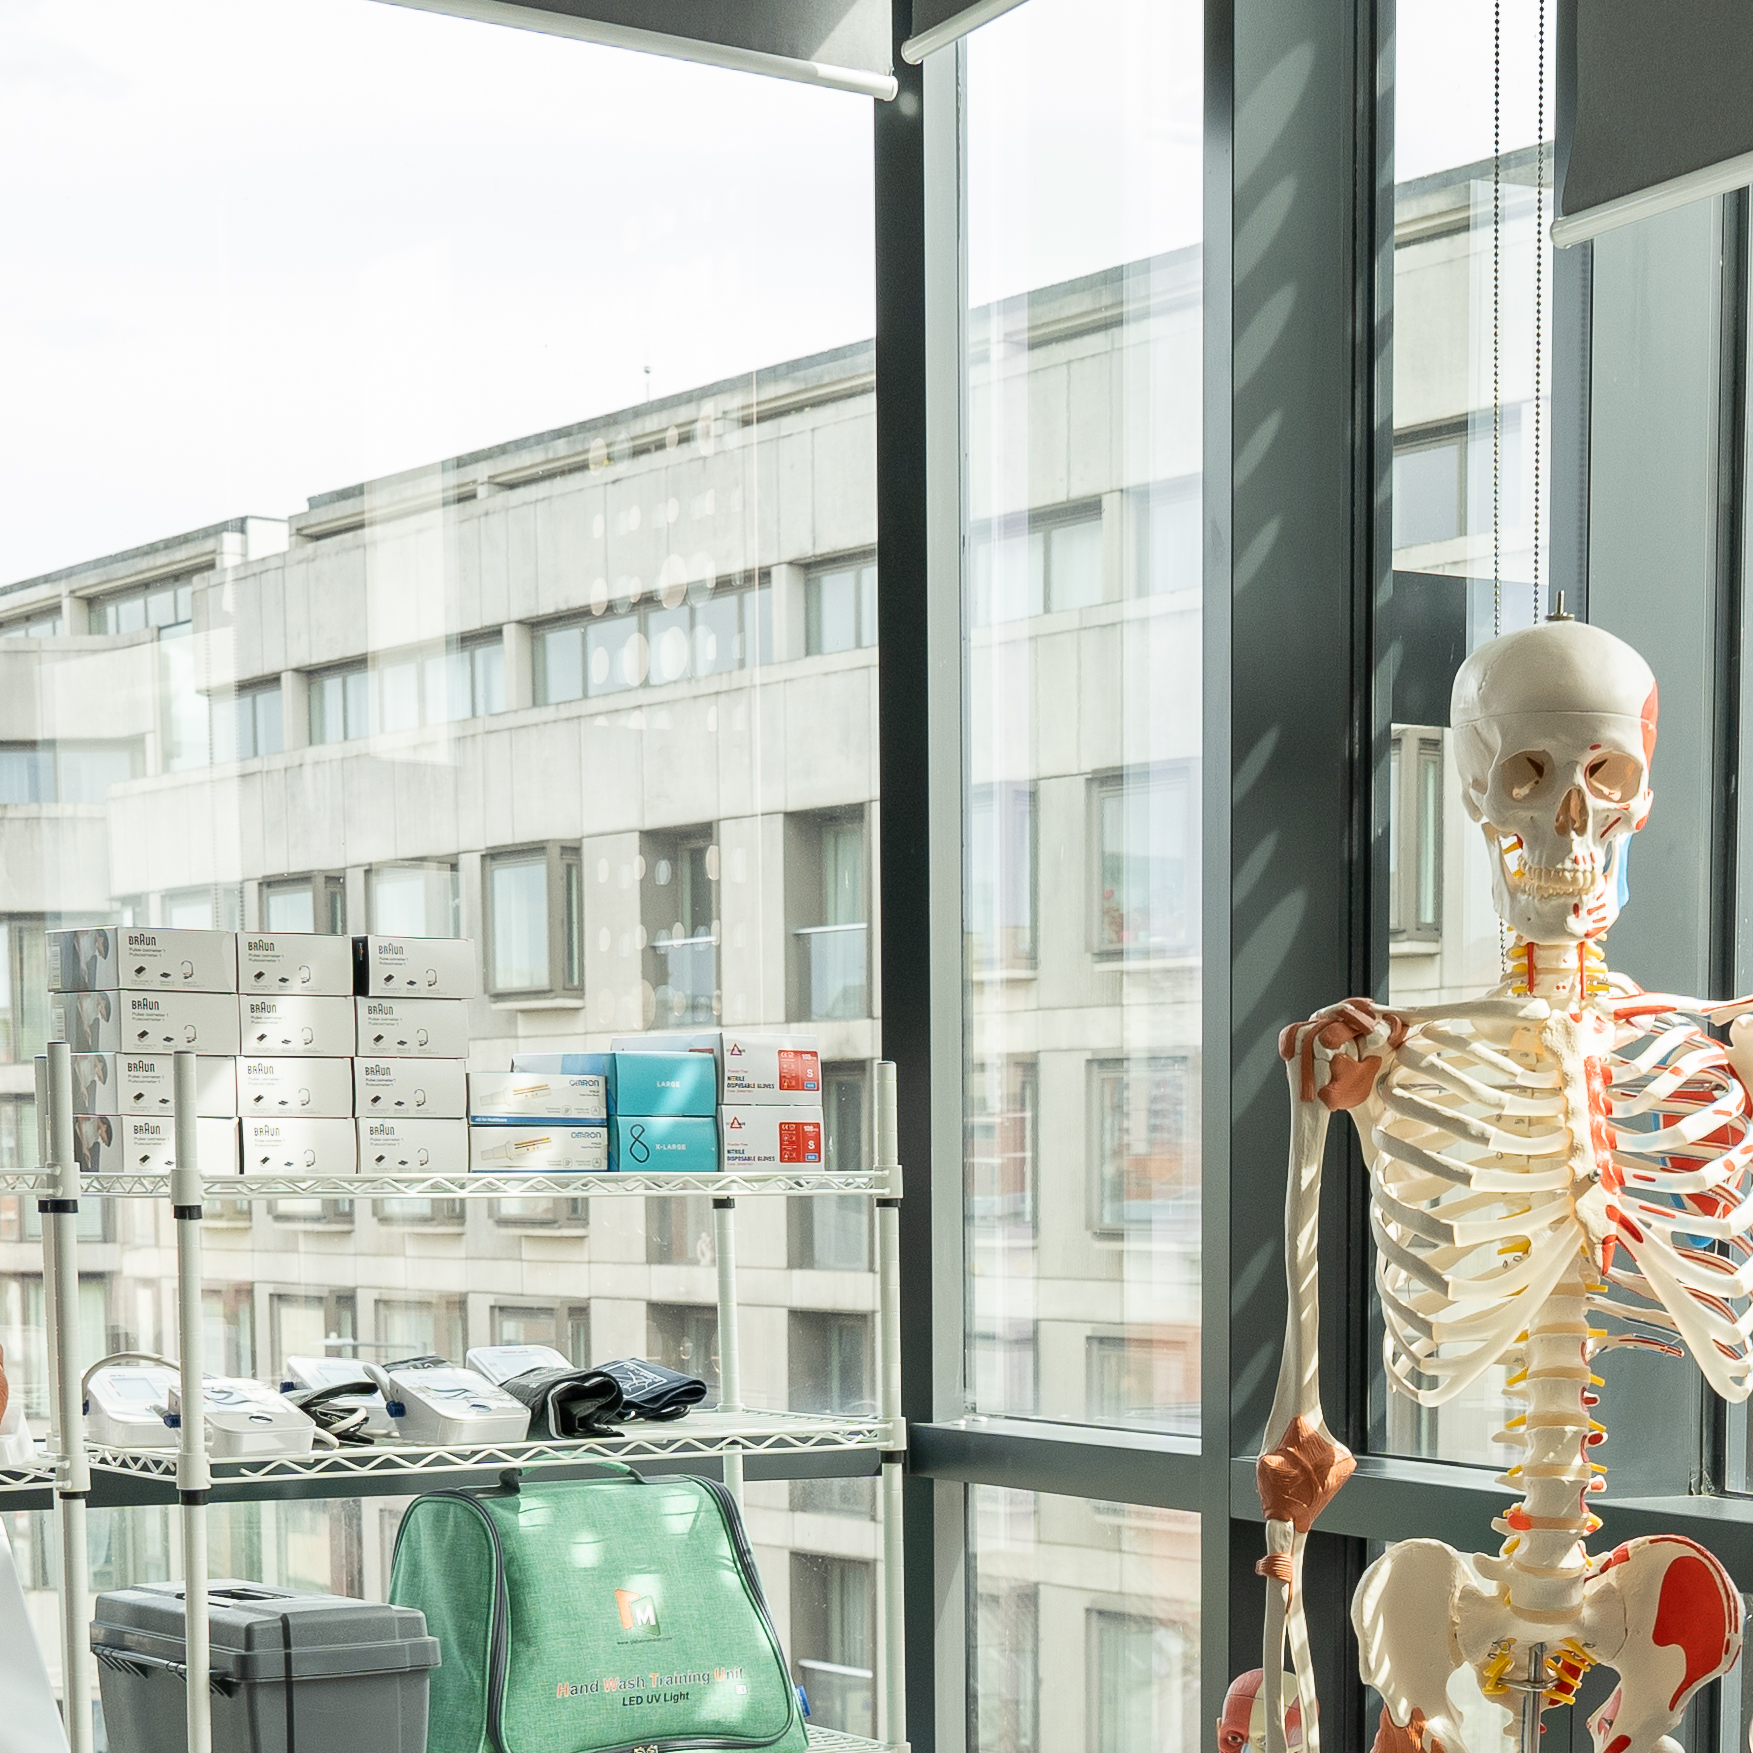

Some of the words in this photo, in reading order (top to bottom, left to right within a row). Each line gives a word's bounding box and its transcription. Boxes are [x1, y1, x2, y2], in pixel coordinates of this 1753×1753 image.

[128, 934, 156, 946] BRAUN
[248, 939, 275, 951] BRAUN
[378, 943, 404, 955] BRAUN
[131, 998, 160, 1010] BRAUN
[250, 1002, 277, 1014] BRAUN
[367, 1003, 394, 1016] BRAUN
[127, 1060, 155, 1073] BRAUN
[248, 1063, 274, 1075] BRAUN
[365, 1064, 391, 1076] BRAUN
[806, 1069, 814, 1078] S
[569, 1079, 600, 1087] OMRON
[133, 1123, 160, 1135] BRAUN
[254, 1125, 280, 1136] BRAUN
[369, 1123, 395, 1136] BRAUN
[571, 1131, 602, 1139] OMRON
[655, 1143, 686, 1151] X-LARGE
[808, 1140, 815, 1150] S
[557, 1680, 599, 1698] Hand
[603, 1676, 645, 1693] Wash
[649, 1670, 710, 1688] Training
[714, 1666, 744, 1681] Unit
[622, 1695, 643, 1707] LED
[646, 1693, 662, 1704] UV
[663, 1691, 690, 1704] Light
